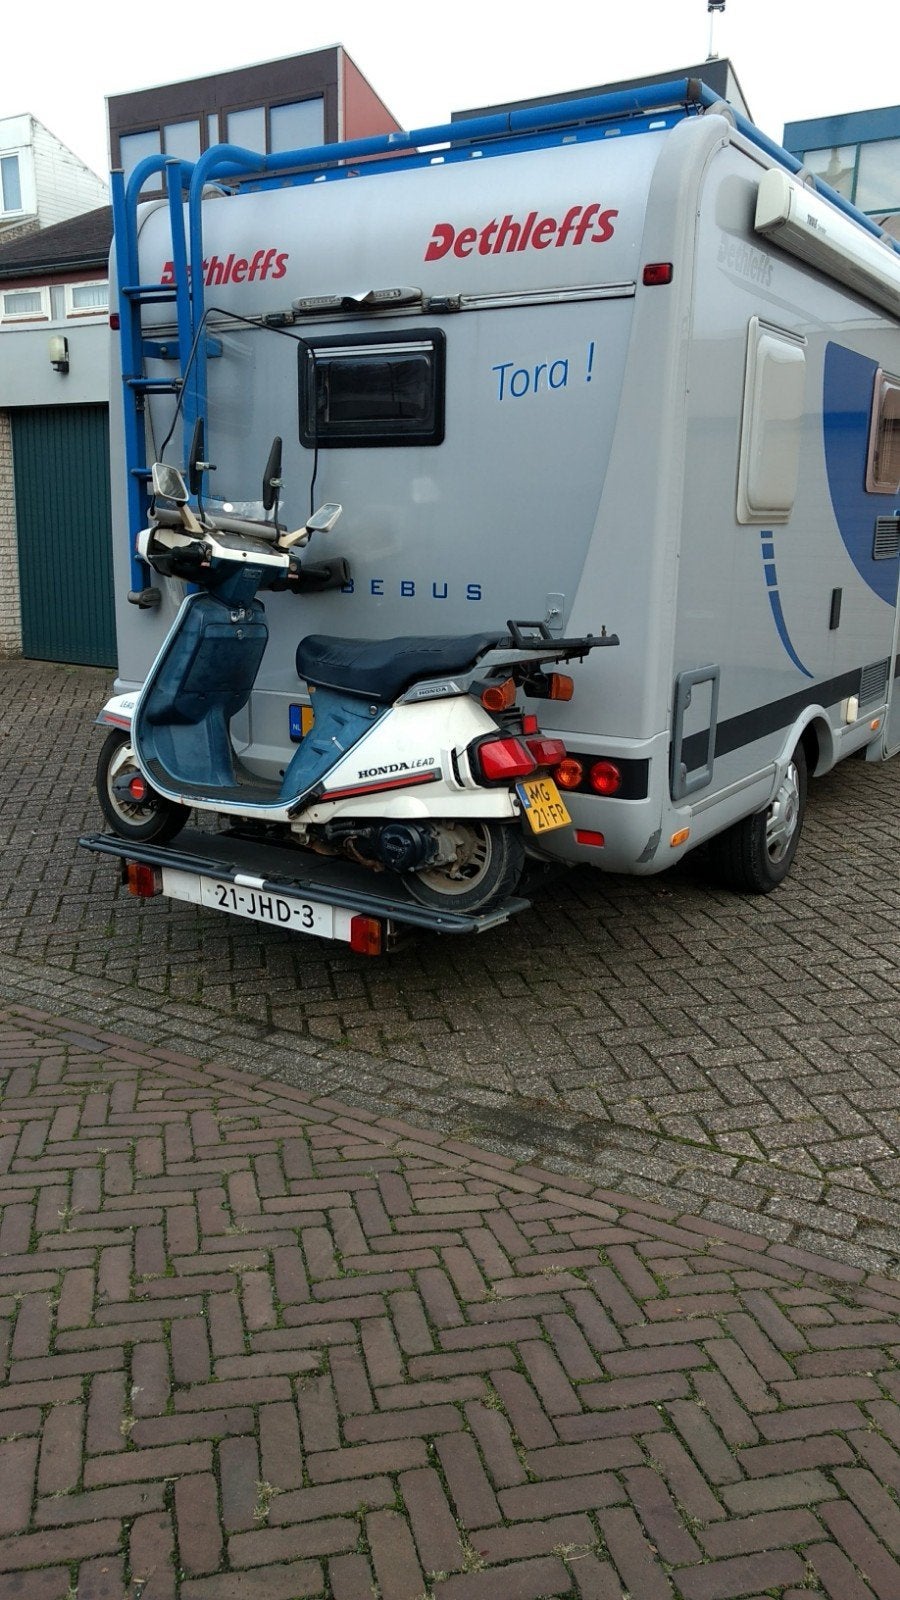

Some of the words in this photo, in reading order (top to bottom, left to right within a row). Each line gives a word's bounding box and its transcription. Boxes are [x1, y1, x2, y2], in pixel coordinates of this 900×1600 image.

[424, 203, 619, 262] Dethleffs
[161, 248, 289, 287] Dhleffs
[491, 358, 569, 401] Tora
[292, 723, 301, 732] NL
[358, 762, 409, 779] HONDA
[411, 757, 435, 769] LEAD
[529, 782, 550, 803] MG
[216, 884, 315, 928] 21-JHD-3
